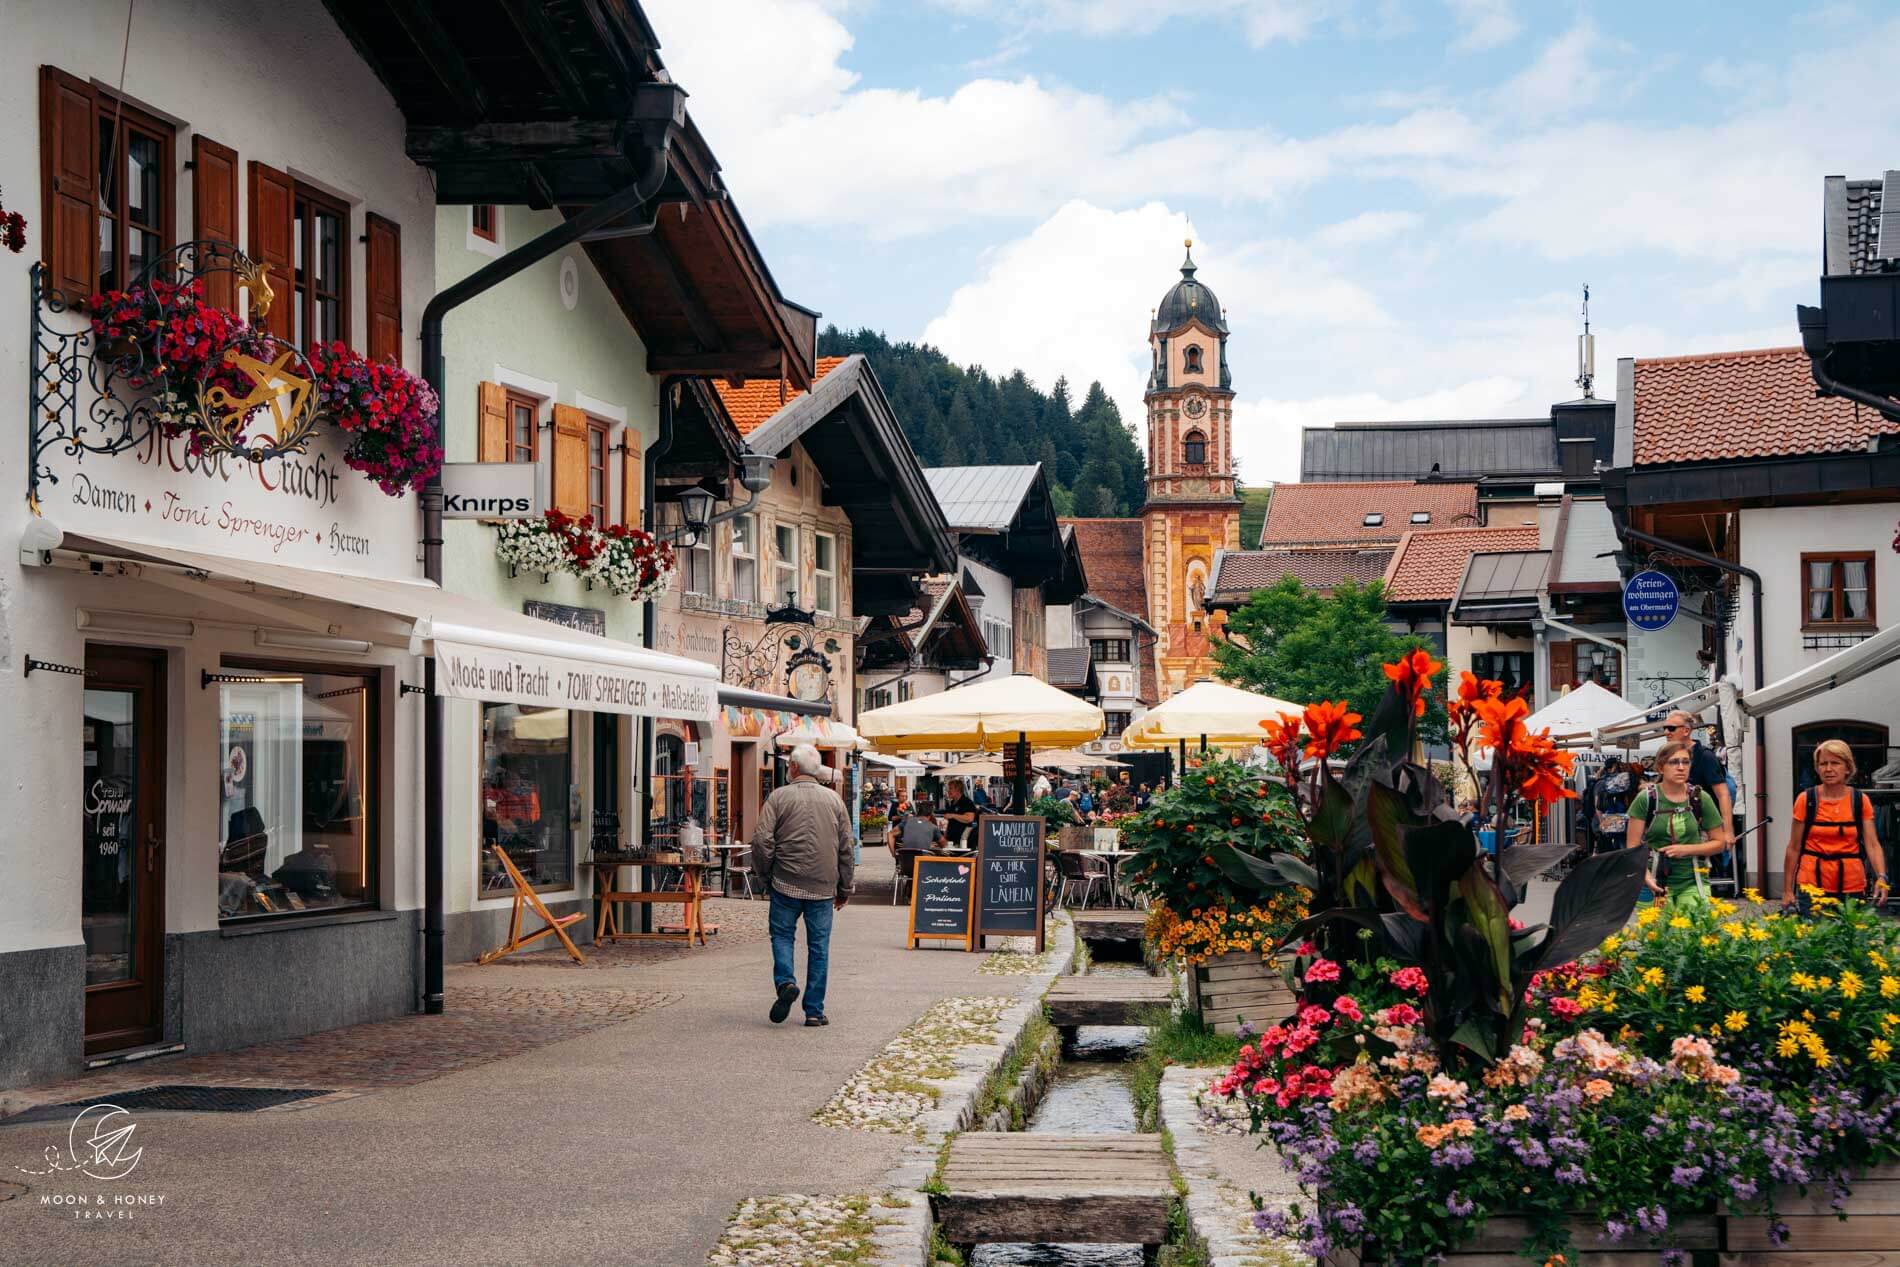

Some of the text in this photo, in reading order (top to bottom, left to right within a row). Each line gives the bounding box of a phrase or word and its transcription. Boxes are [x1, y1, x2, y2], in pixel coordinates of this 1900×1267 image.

[443, 494, 530, 515] Knirps
[72, 472, 369, 556] Damen Toni Sprenger Herren
[1627, 589, 1674, 601] wohnungen
[451, 655, 486, 690] Mode
[490, 662, 513, 694] und
[515, 664, 549, 697] Tracht
[567, 672, 593, 701] TONI
[595, 674, 648, 707] SPRENGER
[102, 822, 115, 837] seit
[99, 841, 119, 856] 1960
[991, 860, 1026, 873] AB HIER
